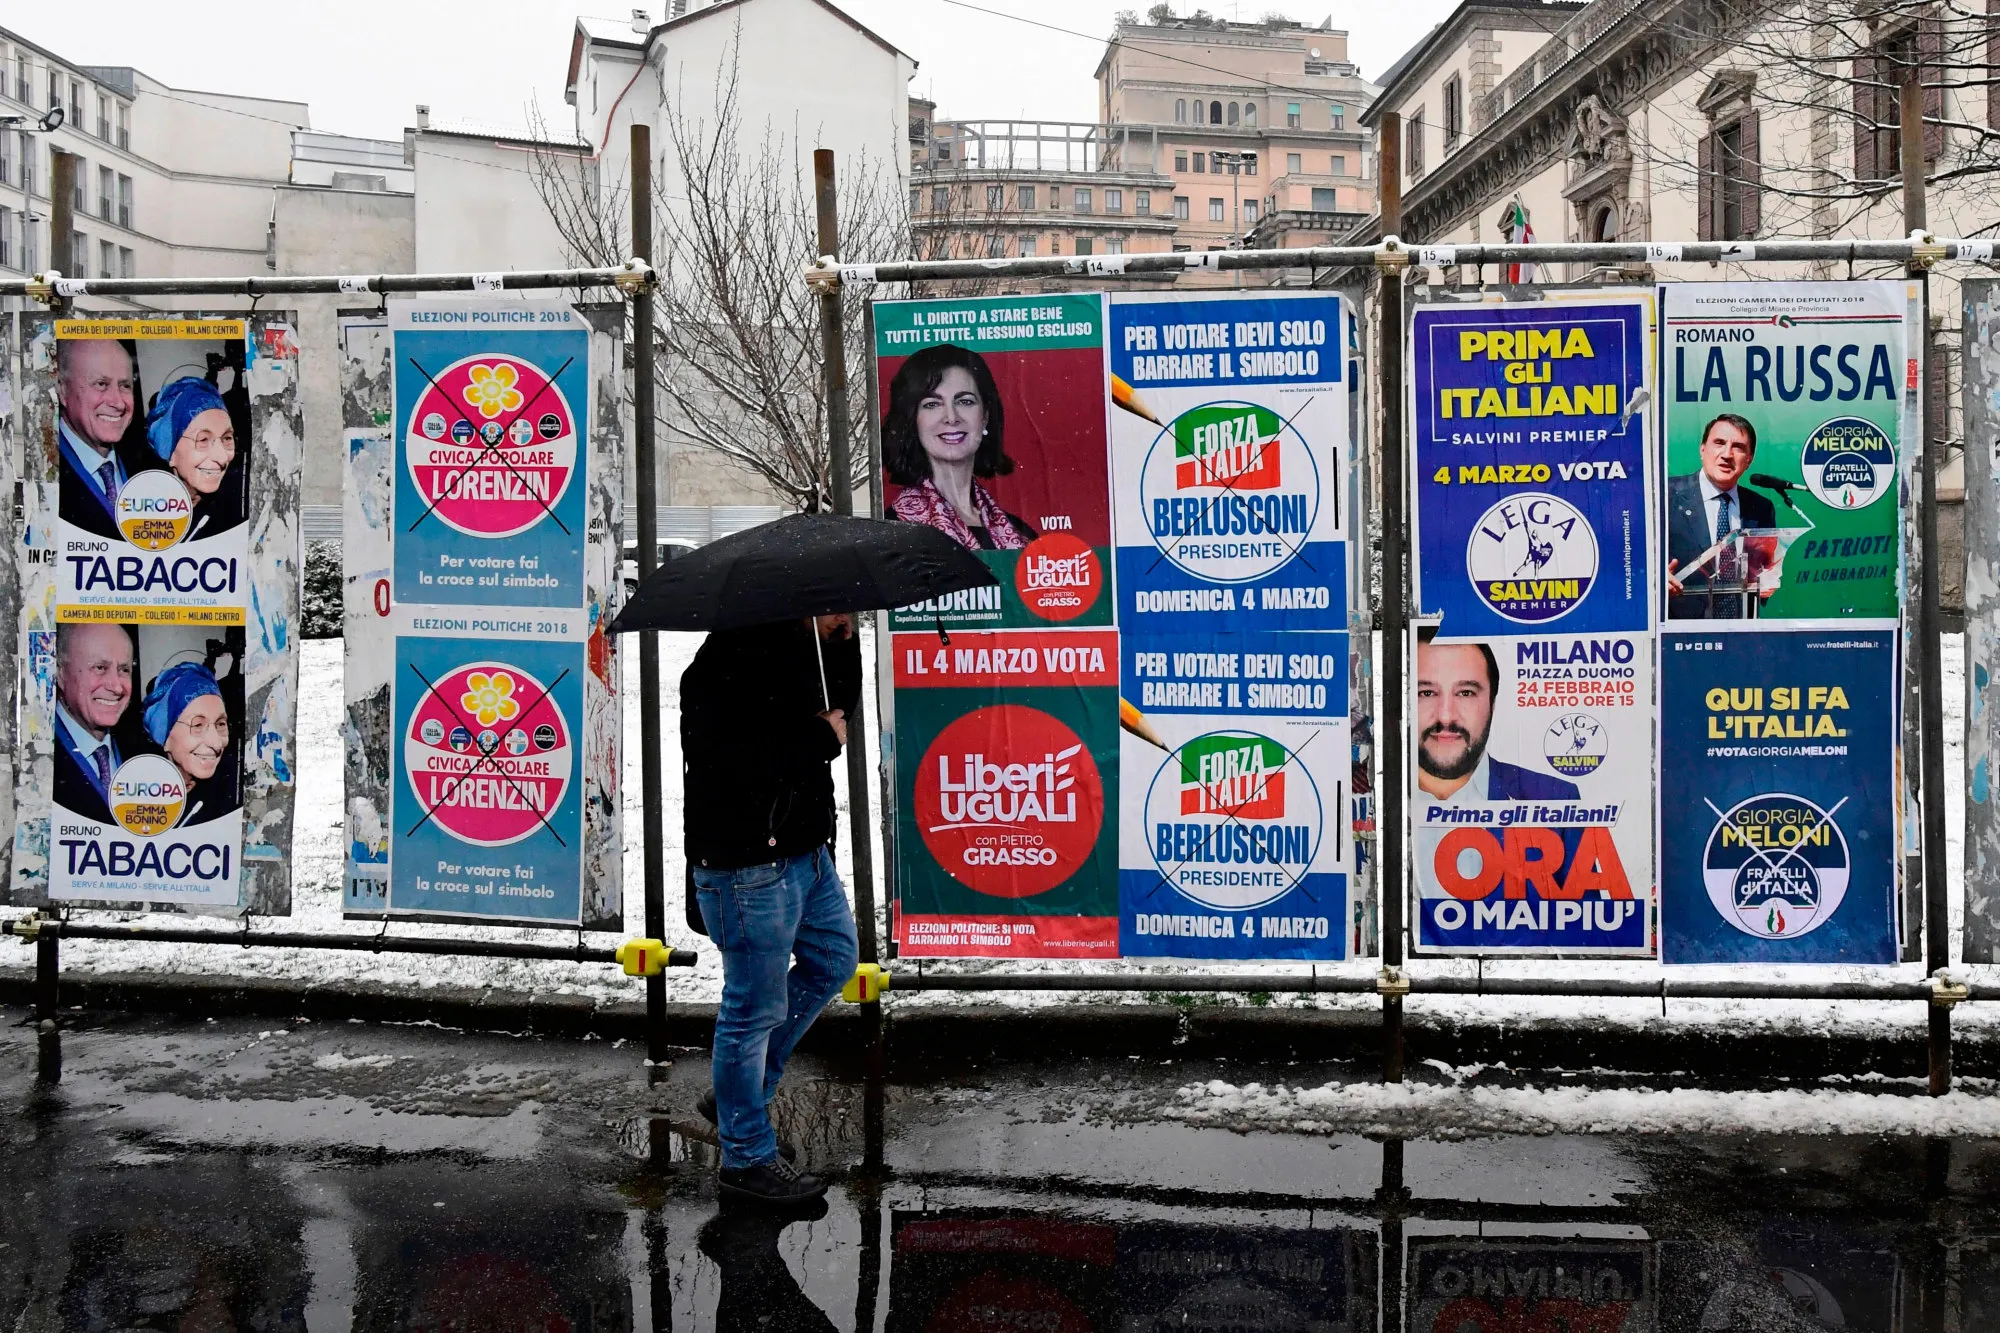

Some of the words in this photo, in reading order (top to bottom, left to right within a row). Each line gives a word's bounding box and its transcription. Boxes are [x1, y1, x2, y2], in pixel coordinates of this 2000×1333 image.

[1424, 250, 1436, 260] 15
[845, 270, 857, 280] 13
[1090, 262, 1103, 272] 14
[341, 280, 352, 288] 24
[490, 281, 501, 290] 36
[412, 312, 468, 323] ELEZIONI
[472, 312, 535, 323] POLITICHE
[540, 312, 570, 323] 2018
[914, 312, 924, 326] IL
[927, 310, 976, 325] DIRITTO
[980, 311, 988, 323] A
[991, 308, 1028, 323] STARE
[1031, 307, 1063, 321] BENE
[1731, 306, 1758, 314] Collegio
[885, 330, 920, 344] TUTTI
[924, 329, 930, 341] E
[933, 327, 974, 341] TUTTE.
[978, 325, 1034, 340] NESSUNO
[1038, 322, 1092, 337] ESCLUSO
[1125, 326, 1156, 351] PER
[1163, 323, 1229, 350] VOTARE
[1235, 322, 1274, 347] DEVI
[1280, 320, 1325, 346] SOLO
[1676, 328, 1755, 342] ROMANO
[1460, 328, 1594, 361] PRIMA
[1133, 354, 1213, 381] BARRARE
[1220, 353, 1234, 378] IL
[1240, 350, 1318, 377] SIMBOLO
[1504, 362, 1551, 384] GLI
[1676, 345, 1732, 402] LA
[1746, 344, 1896, 401] RUSSA
[1441, 385, 1616, 419] ITALIANI
[1193, 414, 1259, 457] FORZA
[1453, 432, 1521, 444] SALVINI
[1530, 430, 1607, 443] PREMIER
[1822, 426, 1873, 437] GIORGIA
[1814, 436, 1883, 451] MELONI
[429, 451, 474, 465] CIVICA
[480, 451, 554, 465] POPOLARE
[1195, 442, 1264, 485] ITALIA
[1434, 466, 1450, 485] 4
[1459, 464, 1551, 484] MARZO
[1558, 461, 1627, 481] VOTA
[1830, 464, 1868, 472] FRATELLI
[1826, 472, 1872, 482] d'ITALIA
[432, 470, 550, 501] LORENZIN
[1041, 516, 1072, 531] VOTA
[1154, 495, 1307, 537] BERLUSCONI
[1482, 501, 1577, 543] LEGA
[144, 521, 174, 530] EMMA
[133, 530, 175, 540] BONINO
[67, 541, 109, 552] BRUNO
[1179, 543, 1282, 560] PRESIDENTE
[1804, 534, 1892, 559] PATRIOTI
[440, 555, 464, 567] Per
[469, 556, 515, 569] votare
[519, 555, 539, 569] fai
[66, 556, 237, 593] TABACCI
[419, 574, 432, 585] la
[437, 575, 474, 586] croce
[479, 574, 499, 586] sul
[503, 574, 558, 588] simbolo
[1813, 565, 1888, 583] LOMBARDIA
[1489, 579, 1578, 601] SALVINI
[79, 596, 105, 605] SERVE
[115, 596, 147, 606] MILANO
[153, 596, 177, 606] SERVE
[1136, 589, 1235, 613] DOMENICA
[1242, 590, 1255, 610] 4
[1263, 587, 1329, 610] MARZO
[1500, 600, 1567, 610] PREMIER
[63, 609, 91, 618] CAMERA
[92, 609, 104, 619] DEI
[106, 610, 137, 620] DEPUTATI
[145, 611, 176, 620] COLLEGIO
[188, 612, 213, 621] MILANO
[215, 612, 240, 622] CENTRO
[1517, 640, 1634, 665] MILANO
[1807, 641, 1879, 649] www.fratelli-italia.it
[907, 649, 928, 674] IL
[933, 649, 948, 673] 4
[955, 648, 1038, 674] MARZO
[1043, 648, 1105, 673] VOTA
[1517, 668, 1573, 678] PIAZZA
[1578, 668, 1634, 679] DUOMO
[1517, 682, 1538, 694] 24
[1544, 681, 1634, 694] FEBBRAIO
[1517, 696, 1579, 707] SABATO
[1583, 696, 1614, 707] ORE
[1620, 696, 1634, 706] 15
[1706, 687, 1763, 711] QUI
[1770, 687, 1800, 710] SI
[1808, 686, 1850, 710] FA
[1550, 716, 1599, 737] LEGA
[1708, 715, 1847, 739] L'ITALIA.
[1707, 746, 1847, 757] #VOTAGIORGIAMELONI
[1553, 755, 1599, 767] SALVINI
[430, 776, 545, 811] LORENZIN
[942, 792, 1076, 822] UGUALI
[1426, 806, 1493, 823] Prima
[1499, 806, 1529, 826] gli
[1532, 804, 1618, 823] italiani!
[1736, 809, 1816, 825] GIORGIA
[976, 836, 996, 845] con
[1001, 835, 1043, 845] PIETRO
[1157, 823, 1309, 864] BERLUSCONI
[1722, 825, 1830, 848] MELONI
[59, 840, 229, 881] TABACCI
[963, 848, 1057, 866] GRASSO
[1434, 827, 1634, 900] ORA
[1747, 867, 1806, 880] FRATELLI
[1741, 880, 1812, 896] d'ITALIA
[1434, 900, 1467, 930] O
[1473, 900, 1548, 930] MAI
[909, 923, 949, 934] ELEZIONI
[1002, 924, 1010, 935] SI
[1012, 924, 1035, 935] VOTA
[908, 934, 959, 945] BARRANDO
[961, 934, 968, 945] IL
[970, 935, 1011, 946] SIMBOLO
[1043, 939, 1115, 949] www.liberieuguali.it
